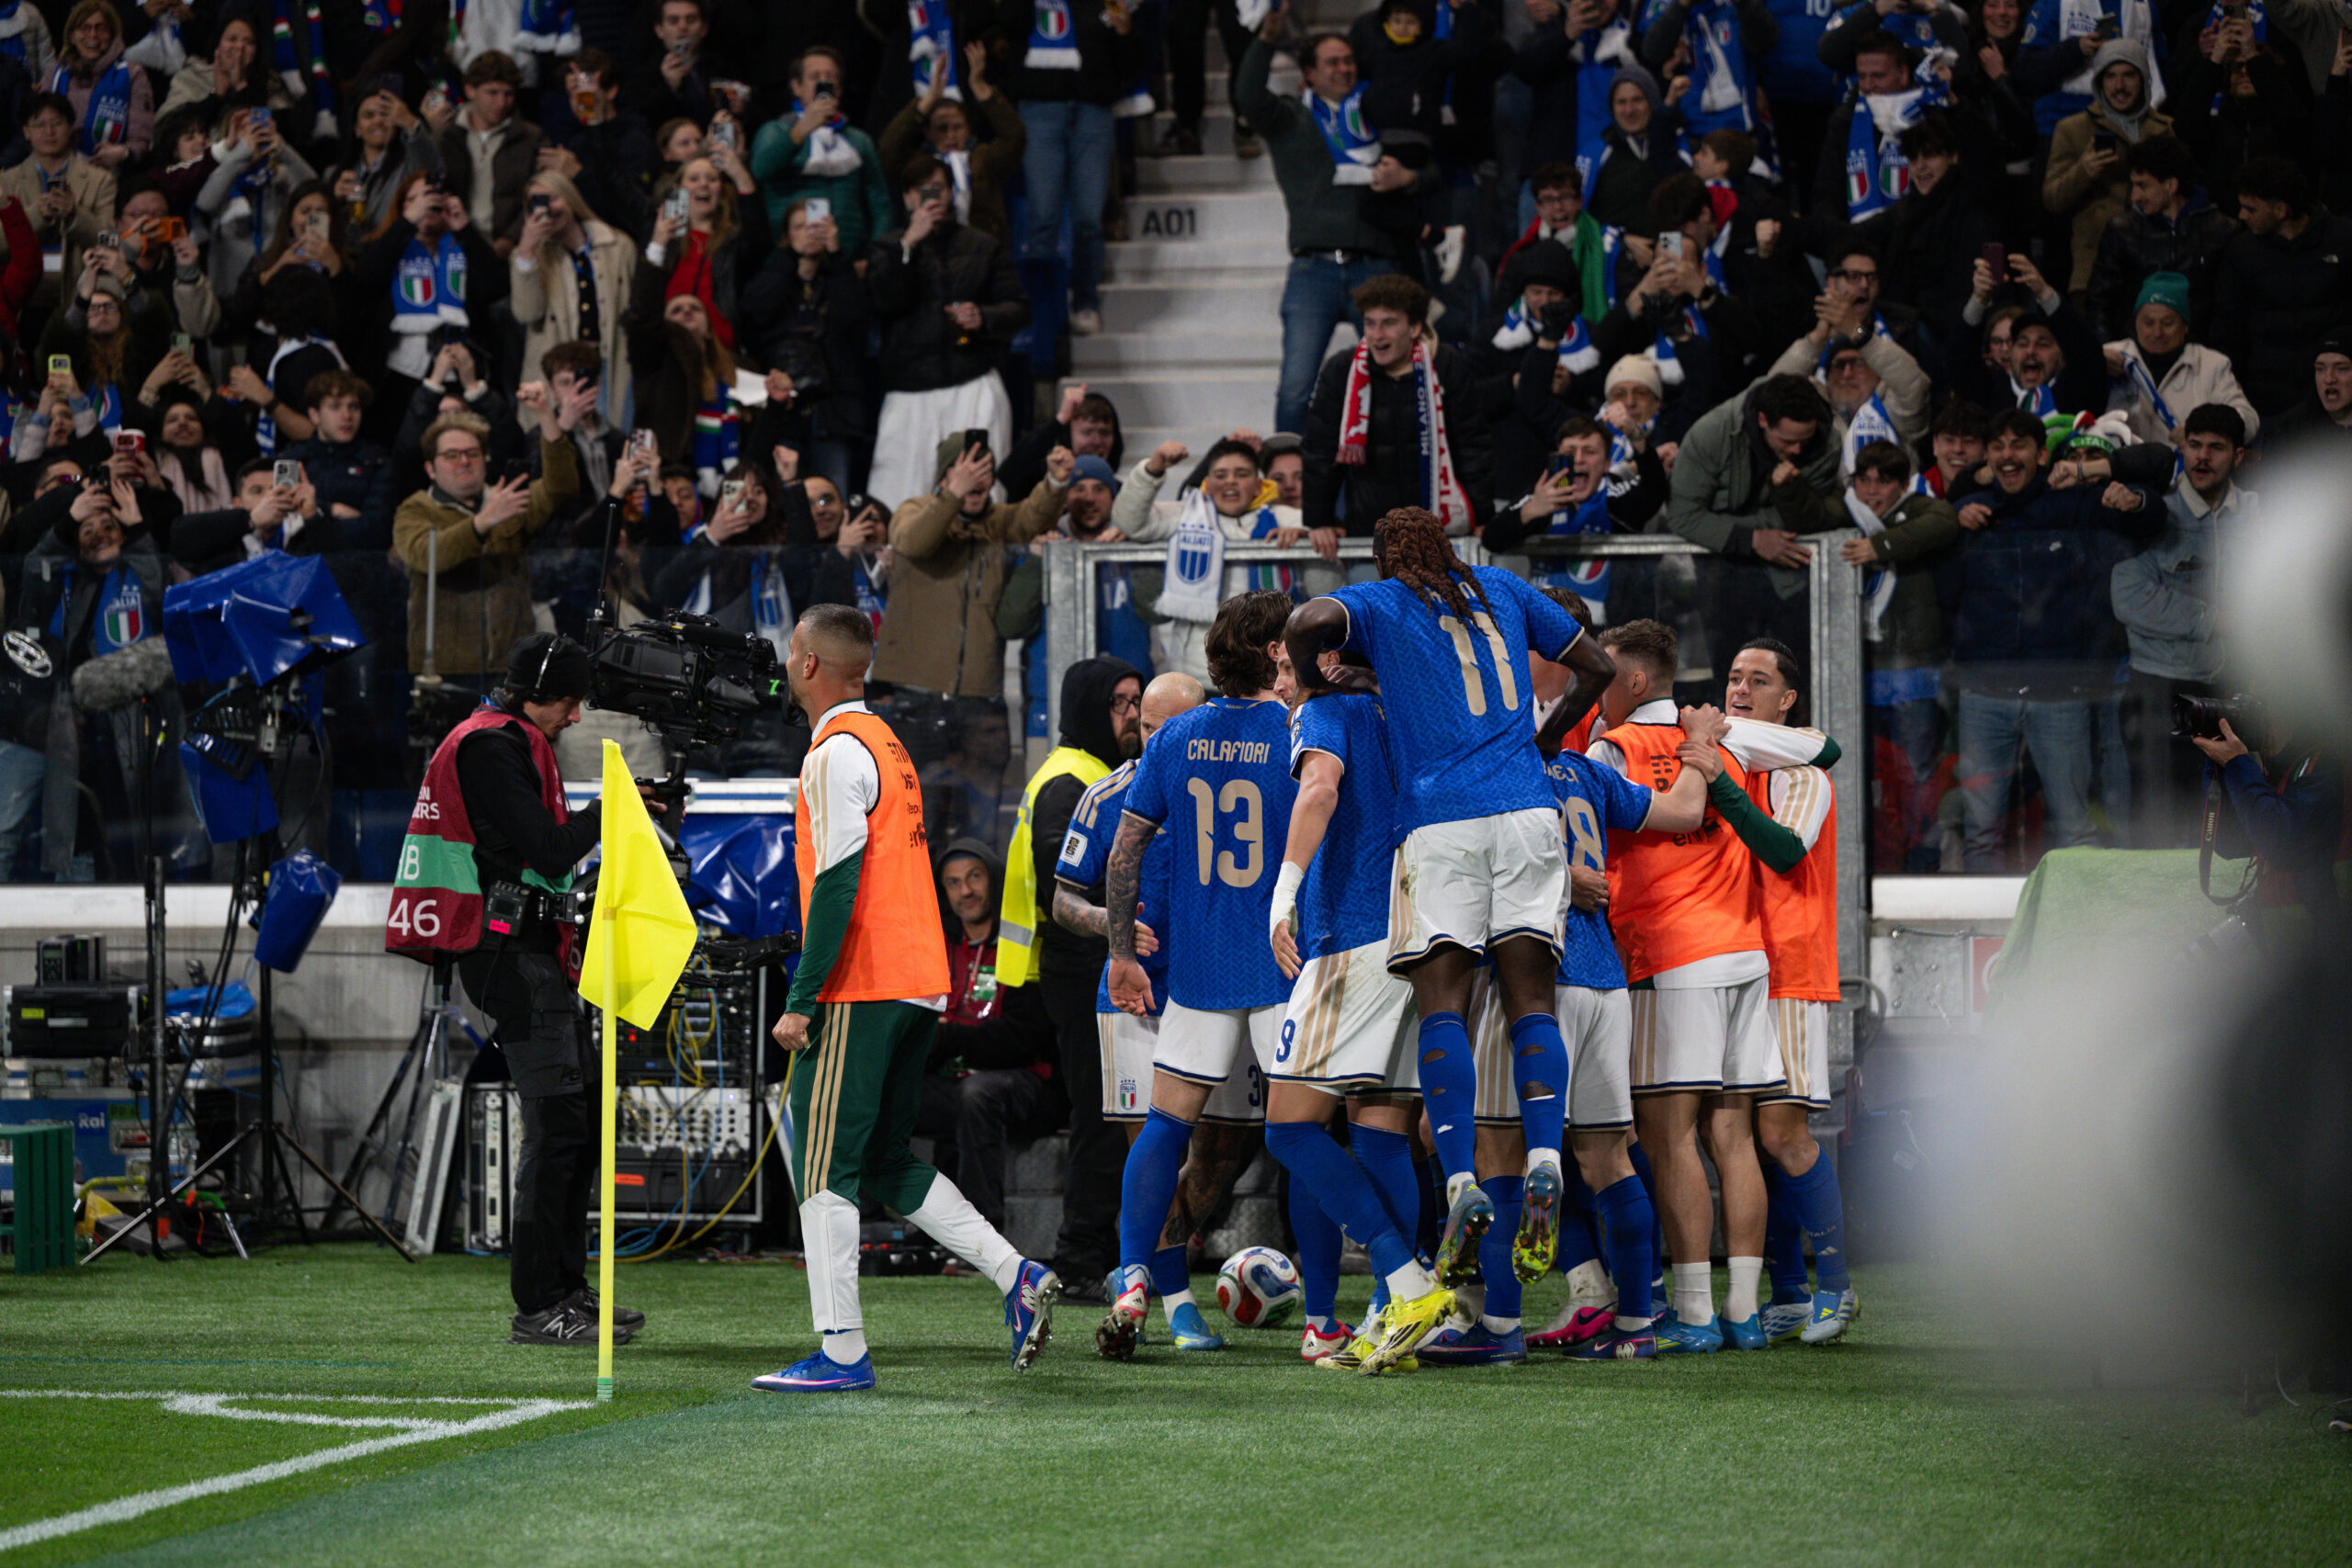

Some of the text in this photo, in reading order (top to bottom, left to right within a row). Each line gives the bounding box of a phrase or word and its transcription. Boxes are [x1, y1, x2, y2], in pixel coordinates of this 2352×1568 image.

[1142, 208, 1196, 236] A01
[1417, 388, 1430, 457] MILANO
[1438, 611, 1520, 716] 11
[769, 679, 780, 695] 7
[1187, 739, 1271, 764] CALAFIORI
[1187, 776, 1264, 888] 13
[2205, 812, 2215, 841] Canon
[388, 898, 441, 938] 46
[1276, 1019, 1296, 1063] 9
[1248, 1065, 1261, 1107] 3
[77, 1111, 106, 1130] Rai
